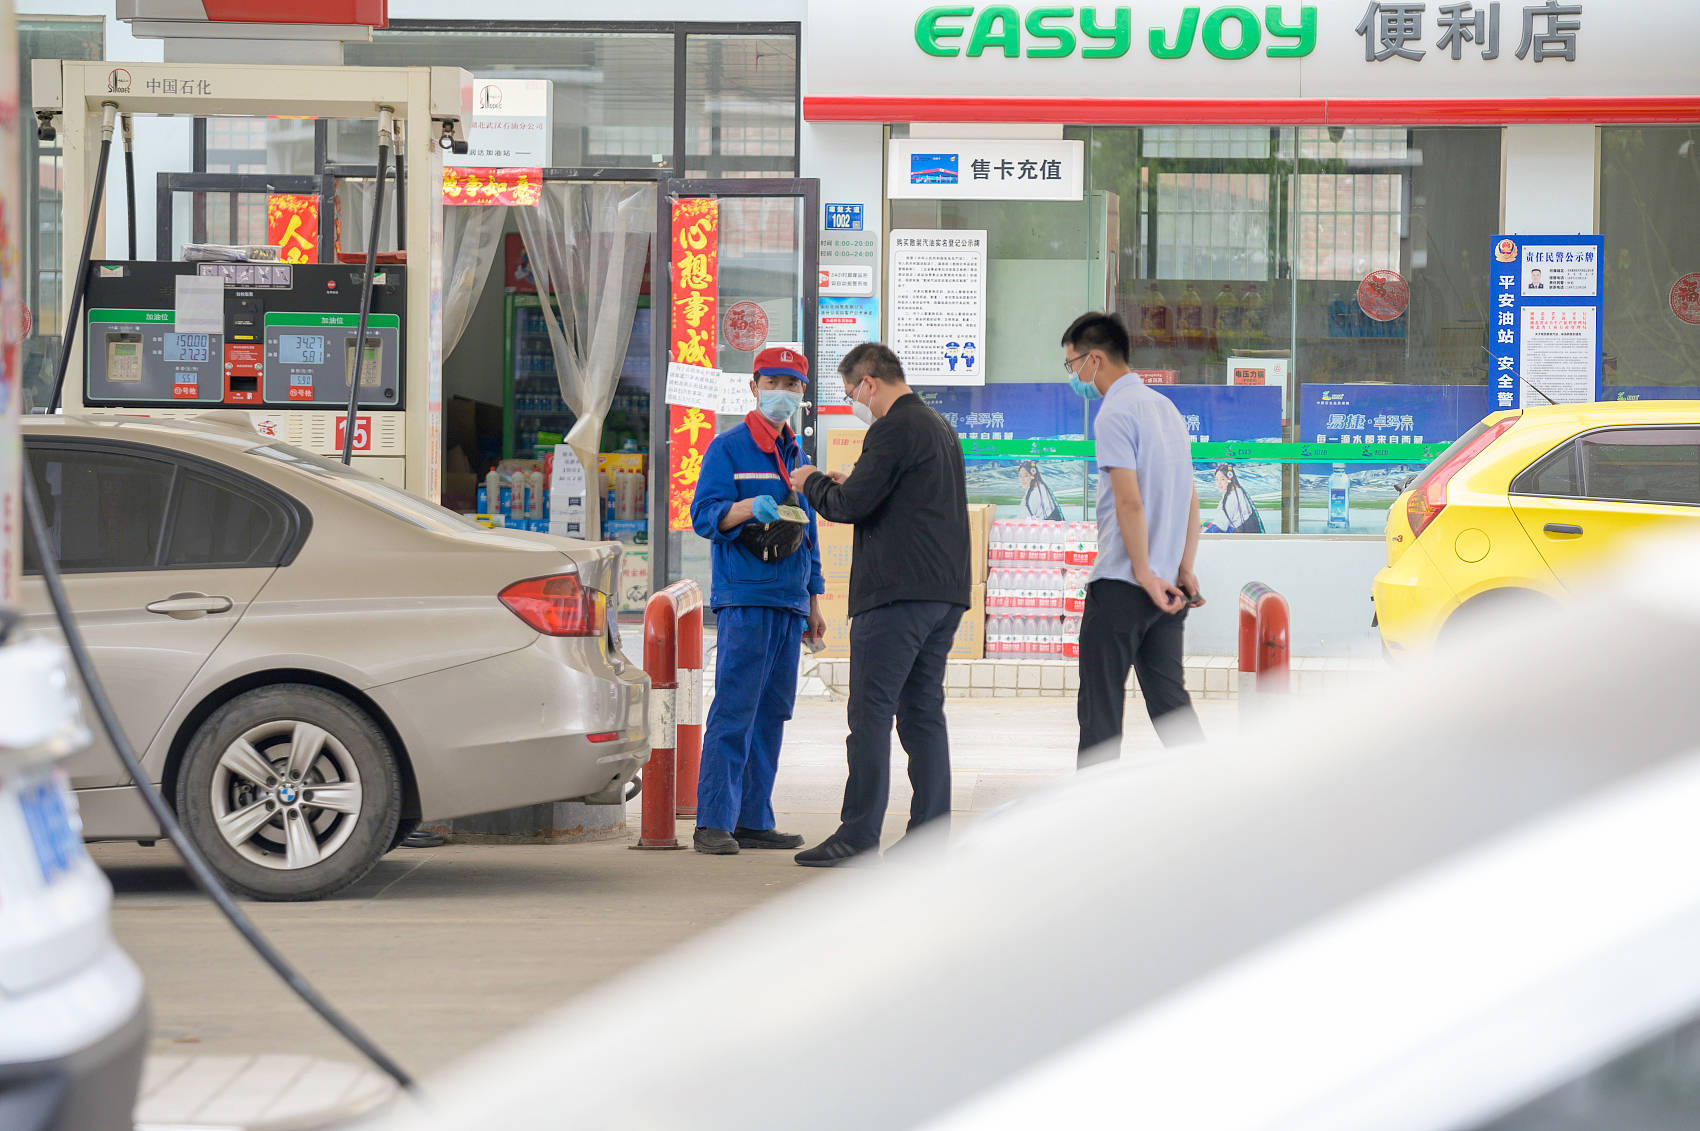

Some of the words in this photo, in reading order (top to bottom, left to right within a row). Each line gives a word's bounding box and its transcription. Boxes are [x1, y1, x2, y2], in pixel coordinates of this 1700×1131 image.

[914, 5, 1130, 58] EASY
[1149, 5, 1317, 59] JOY
[1355, 1, 1583, 62] 便利店
[146, 78, 212, 95] 中国石化
[970, 158, 1062, 182] 售卡充值
[832, 213, 851, 228] 1002
[1526, 251, 1594, 263] 责任民警公示牌
[146, 313, 169, 321] 加油位
[1498, 275, 1515, 344] 平安油站
[321, 317, 344, 325] 加油位
[339, 419, 368, 448] 15
